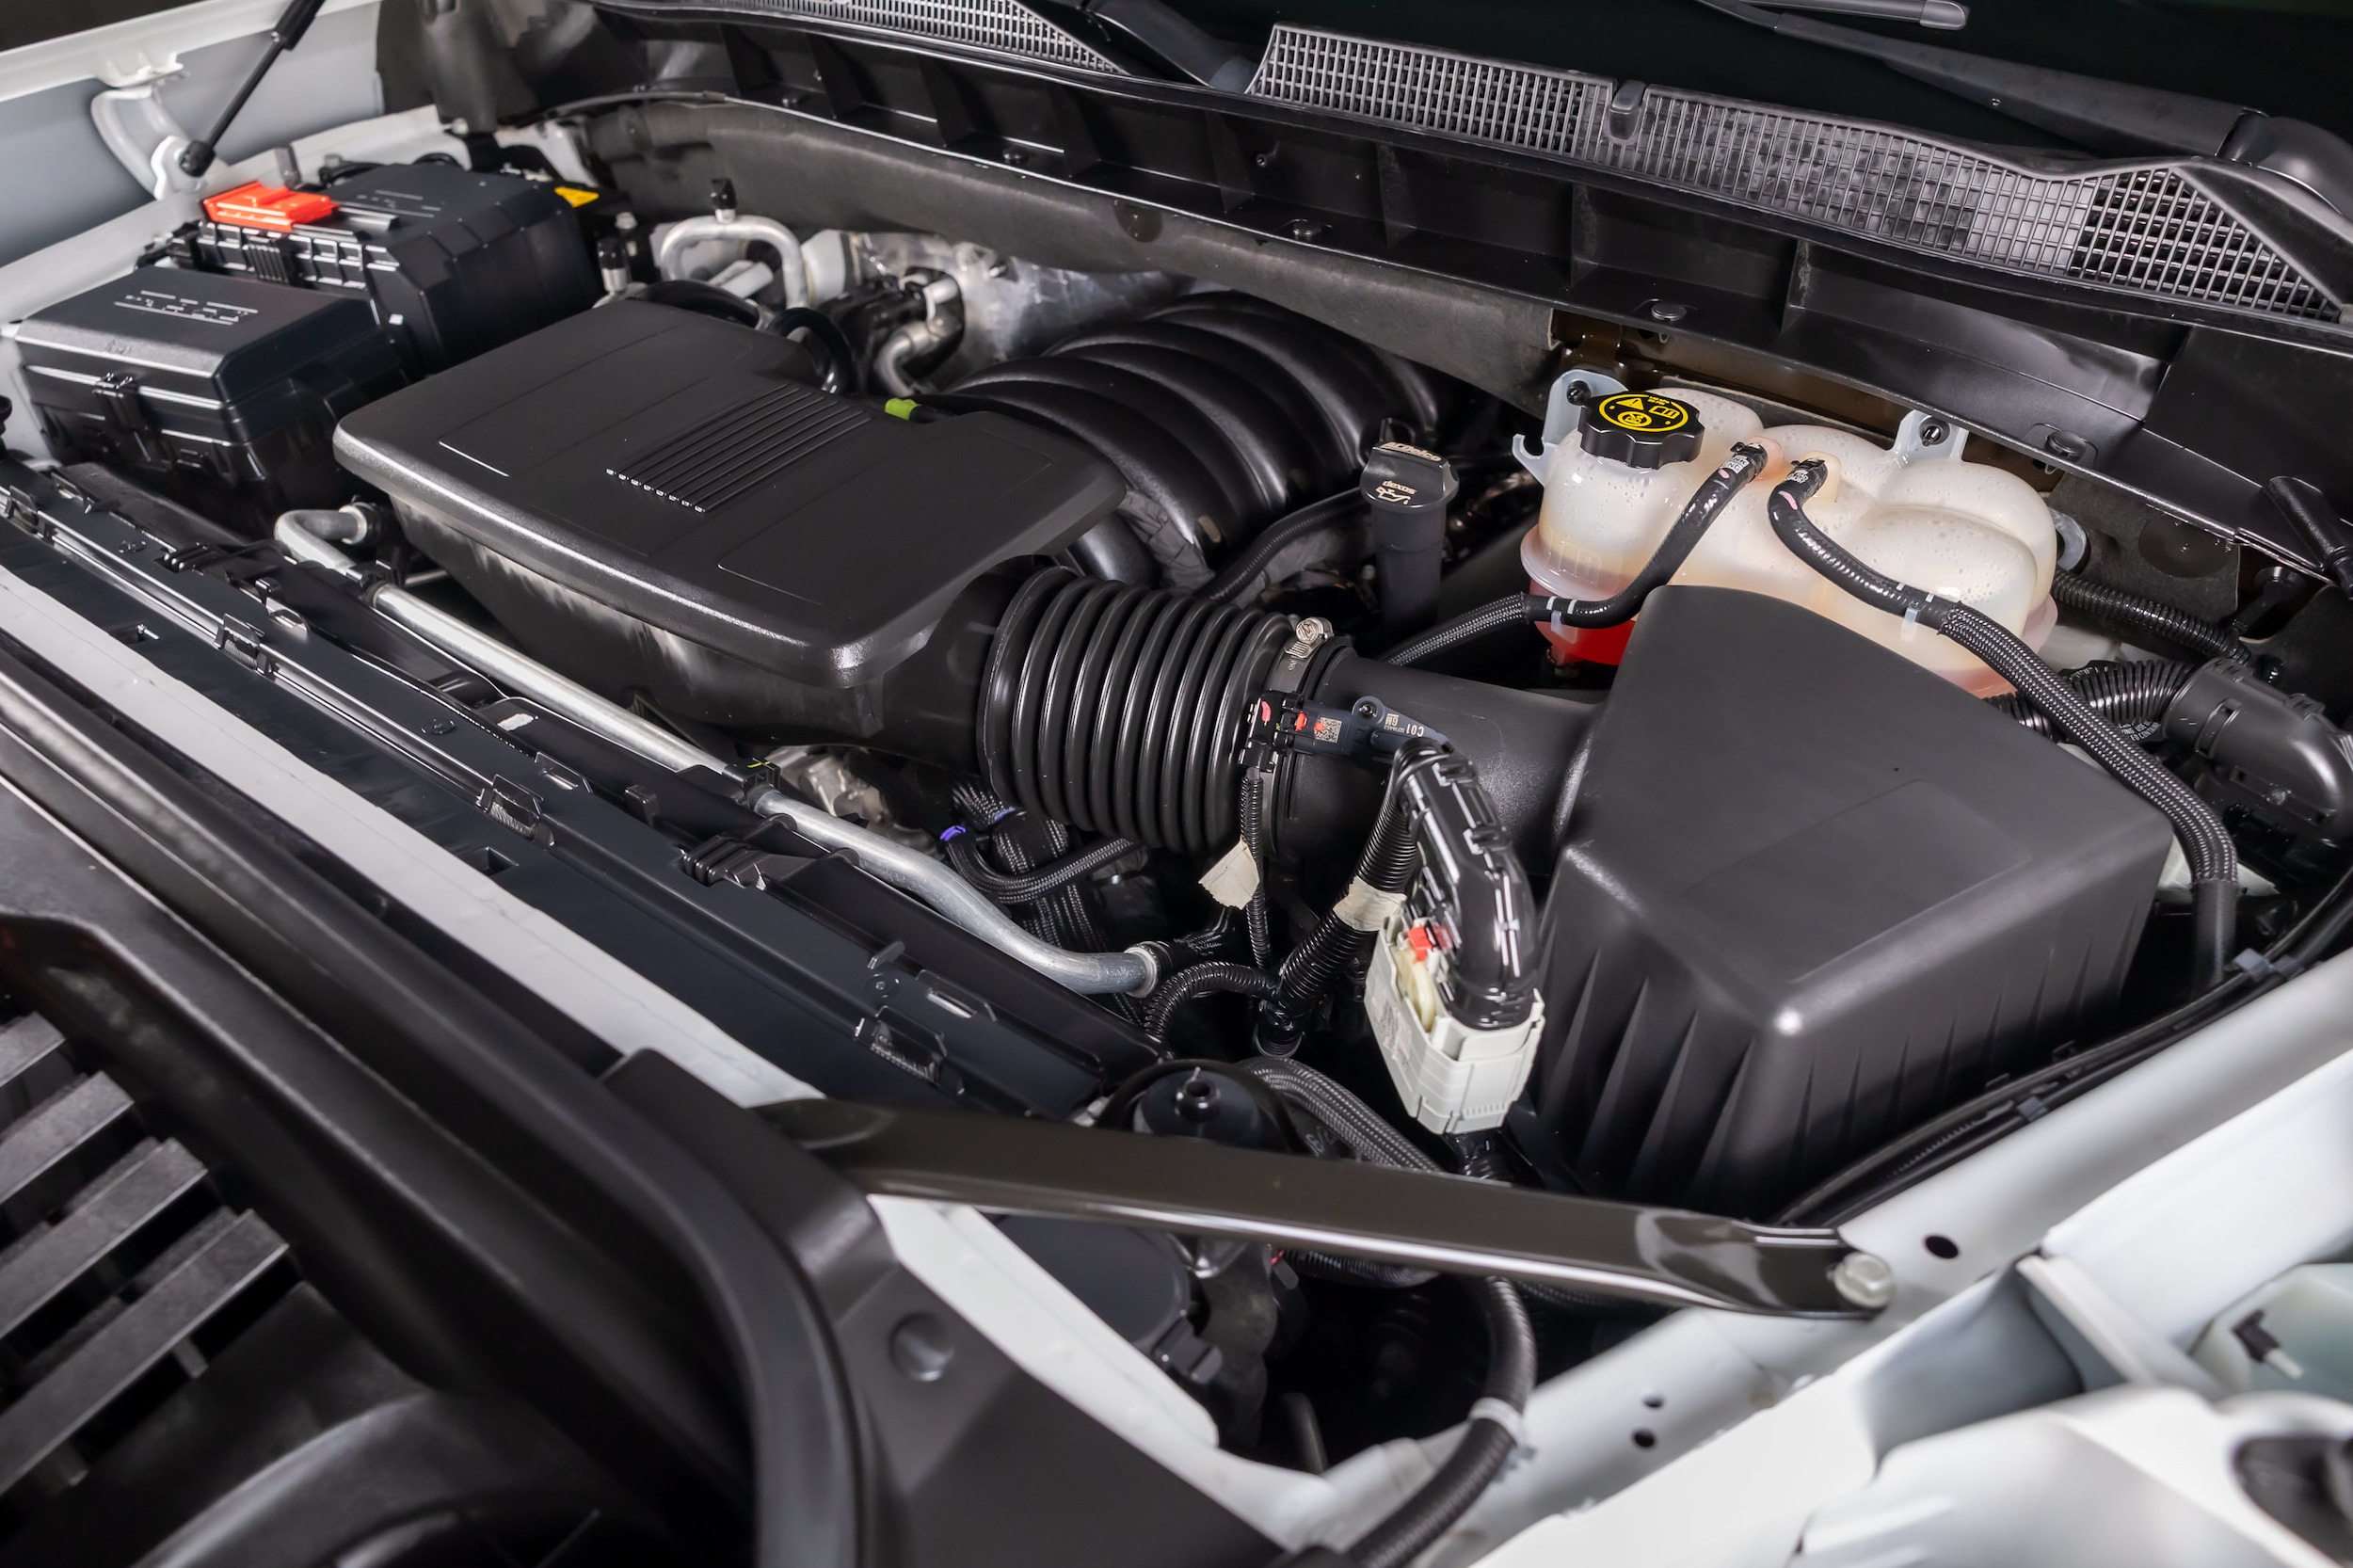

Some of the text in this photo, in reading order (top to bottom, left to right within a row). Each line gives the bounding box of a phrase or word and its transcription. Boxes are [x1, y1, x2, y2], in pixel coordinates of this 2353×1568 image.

[1380, 441, 1442, 462] ACDelco
[1382, 480, 1417, 495] dexos
[1385, 715, 1400, 727] GM
[1406, 723, 1425, 737] C01
